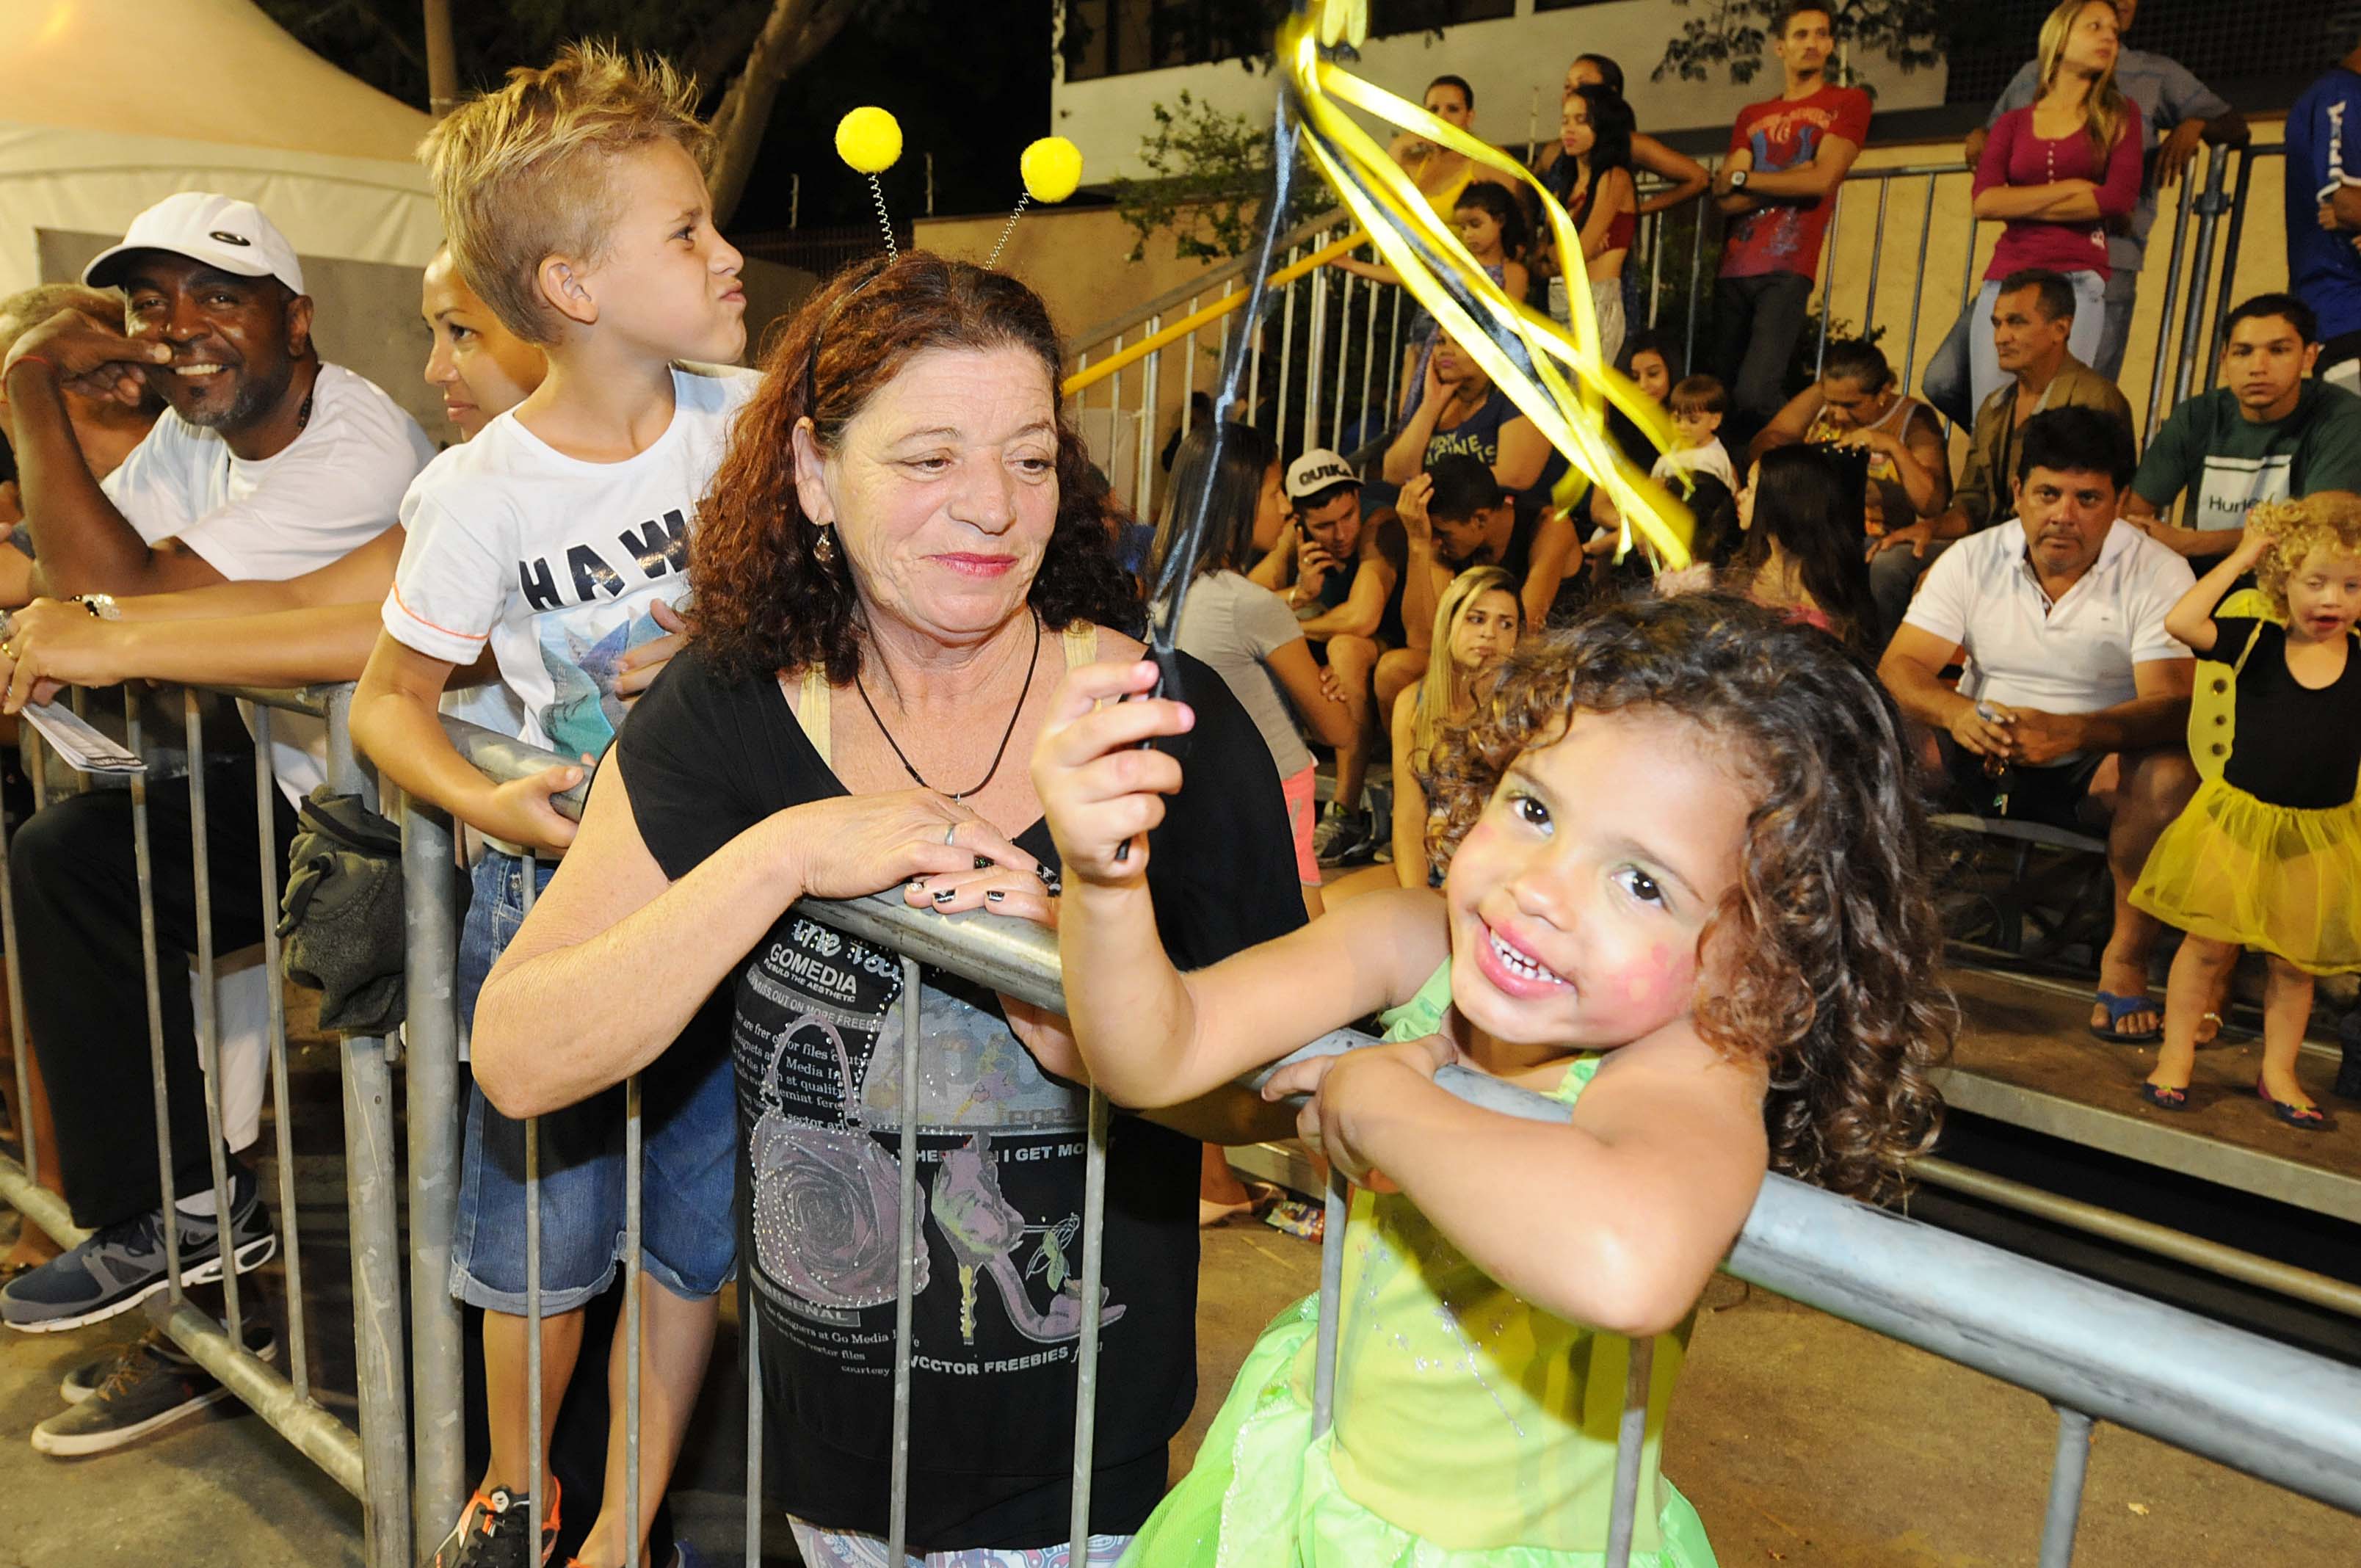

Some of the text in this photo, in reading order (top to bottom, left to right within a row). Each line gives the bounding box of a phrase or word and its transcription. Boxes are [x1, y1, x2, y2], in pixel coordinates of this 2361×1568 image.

[770, 943, 856, 994] GOMEDIA
[791, 973, 806, 986] THE
[807, 981, 855, 1003] AESTHETIC
[772, 990, 790, 1006] OUT
[790, 997, 805, 1012] ON
[806, 1004, 835, 1024] MORE
[837, 1015, 886, 1032] FREEBIE
[802, 1043, 828, 1059] files
[786, 1056, 823, 1078] Media
[1015, 1146, 1053, 1162] GET
[852, 1333, 889, 1344] Media
[841, 1350, 866, 1360] files
[984, 1346, 1069, 1373] FREEBIES
